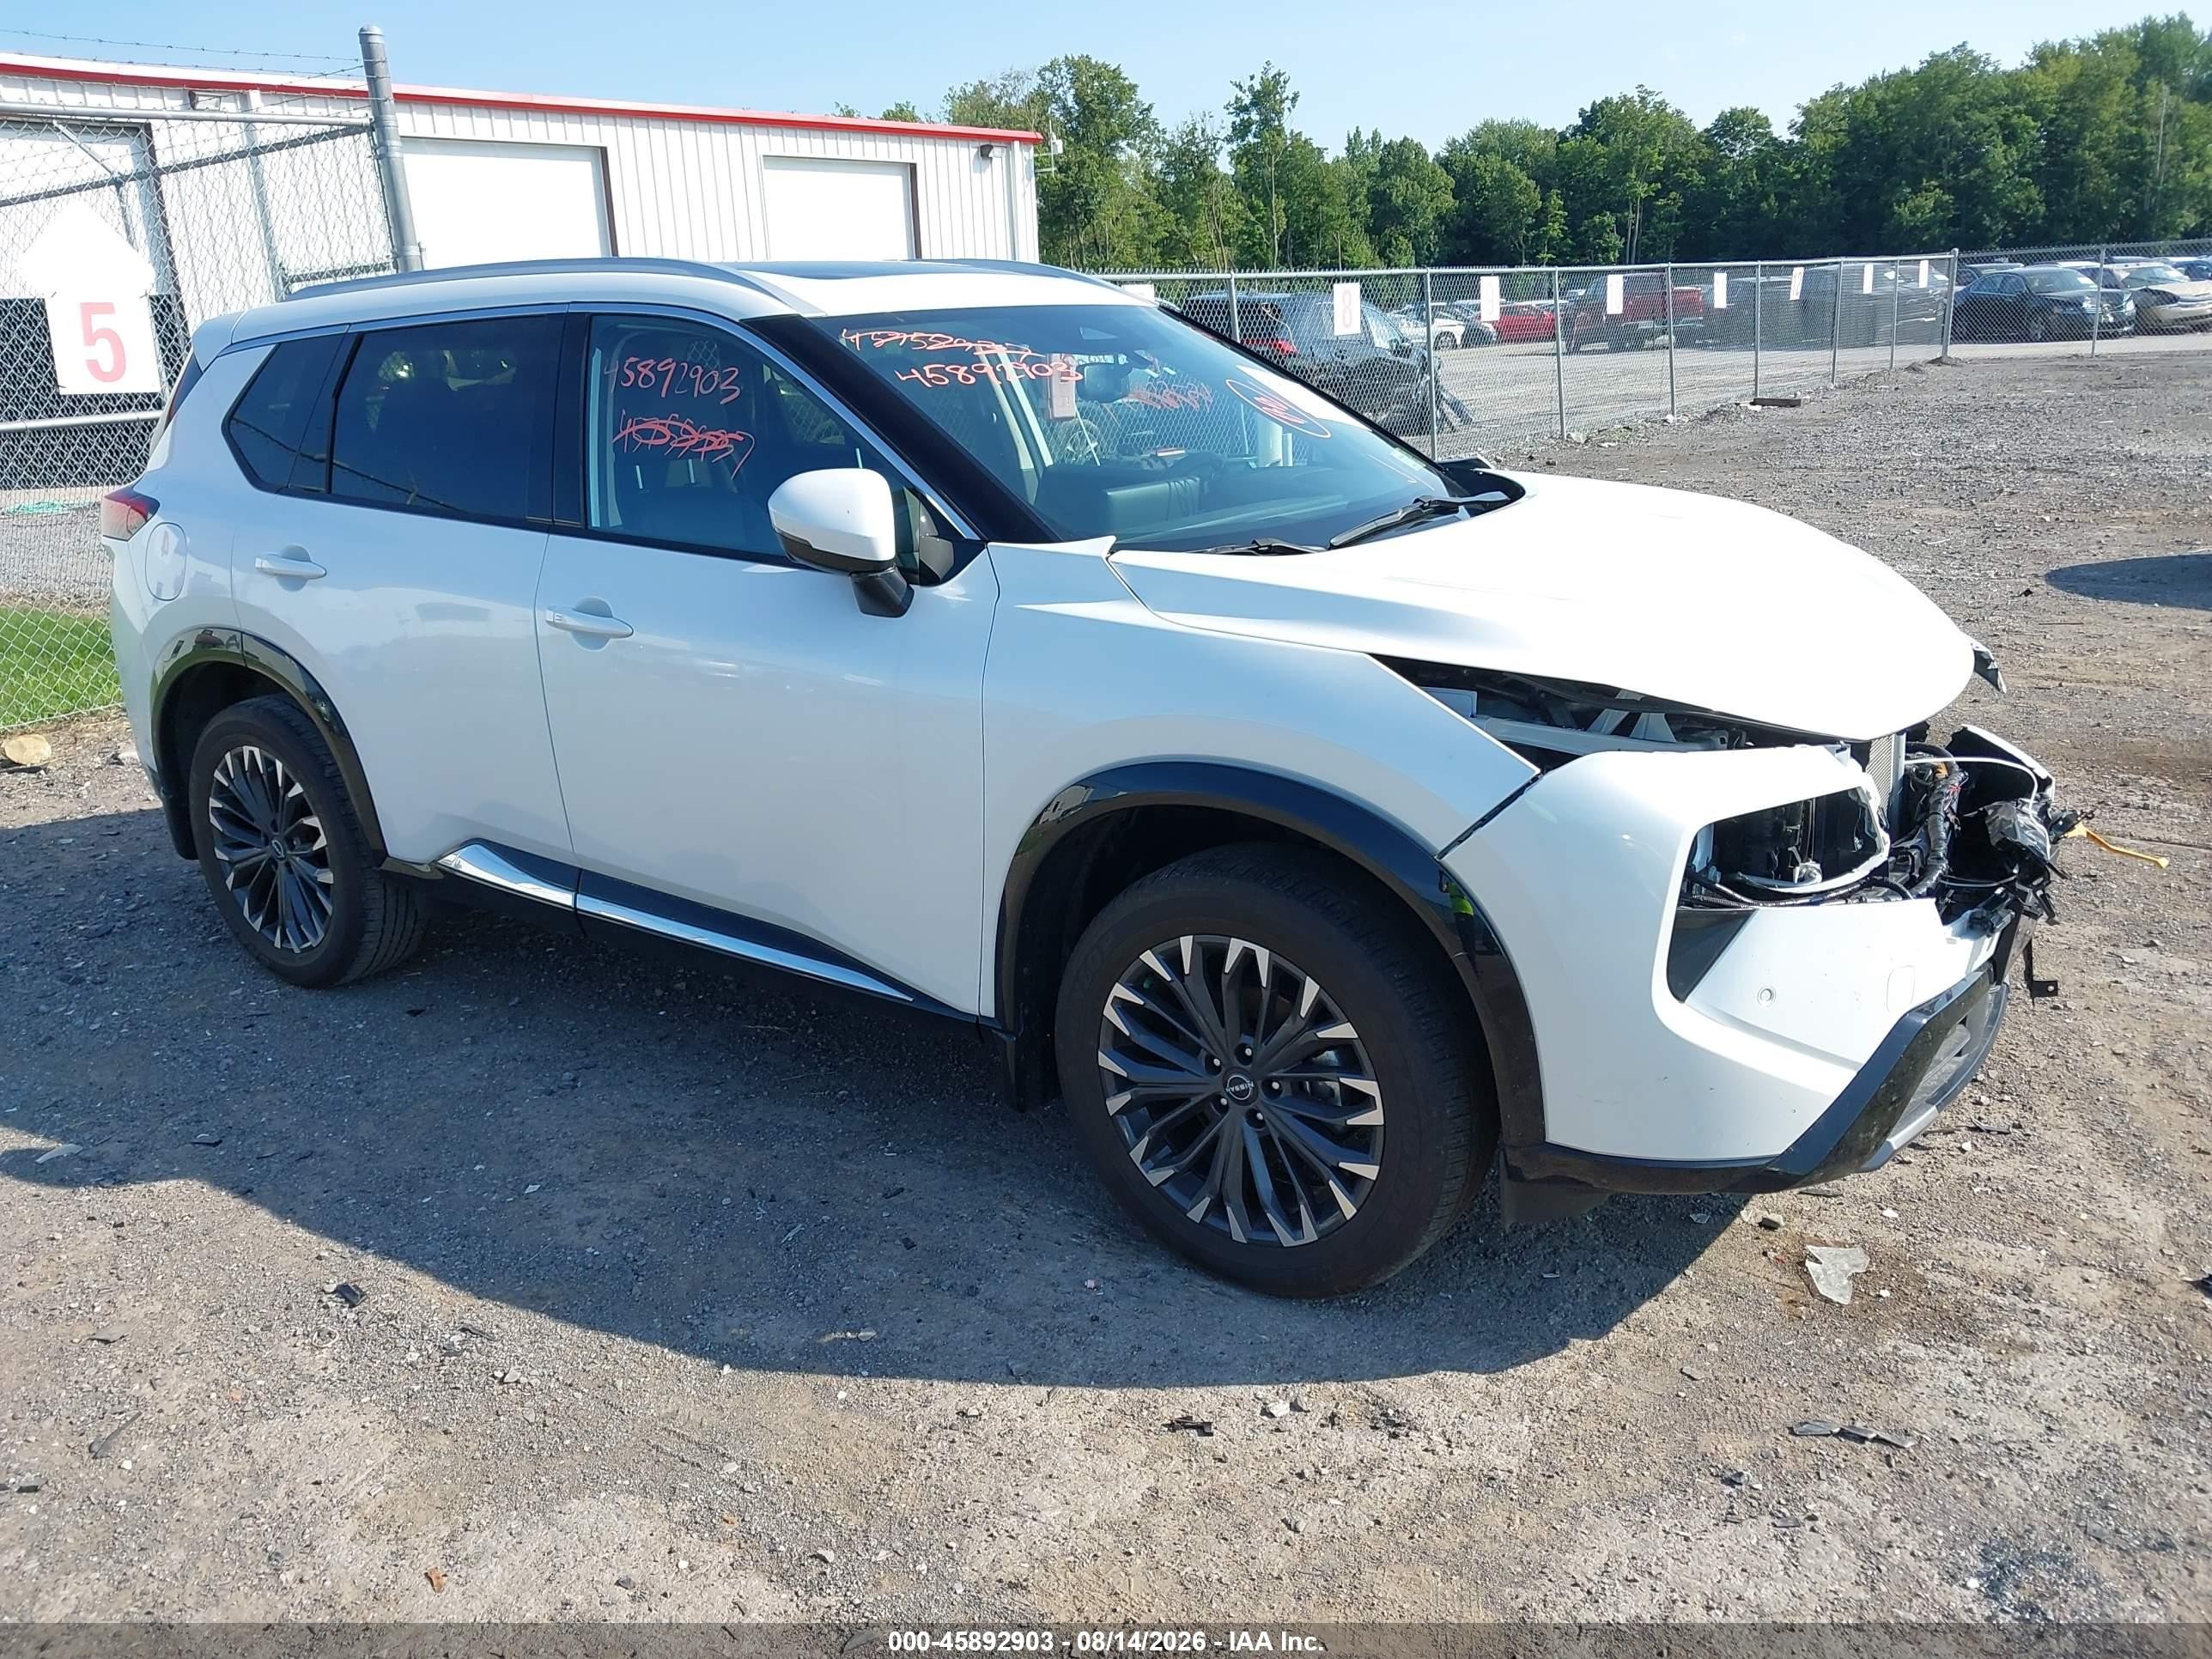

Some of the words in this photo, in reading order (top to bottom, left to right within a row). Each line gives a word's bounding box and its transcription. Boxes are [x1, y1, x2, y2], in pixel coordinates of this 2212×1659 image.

[1341, 289, 1353, 329] 8
[80, 302, 126, 383] 5
[604, 356, 741, 404] 45892903
[1225, 1081, 1255, 1093] NISSAN
